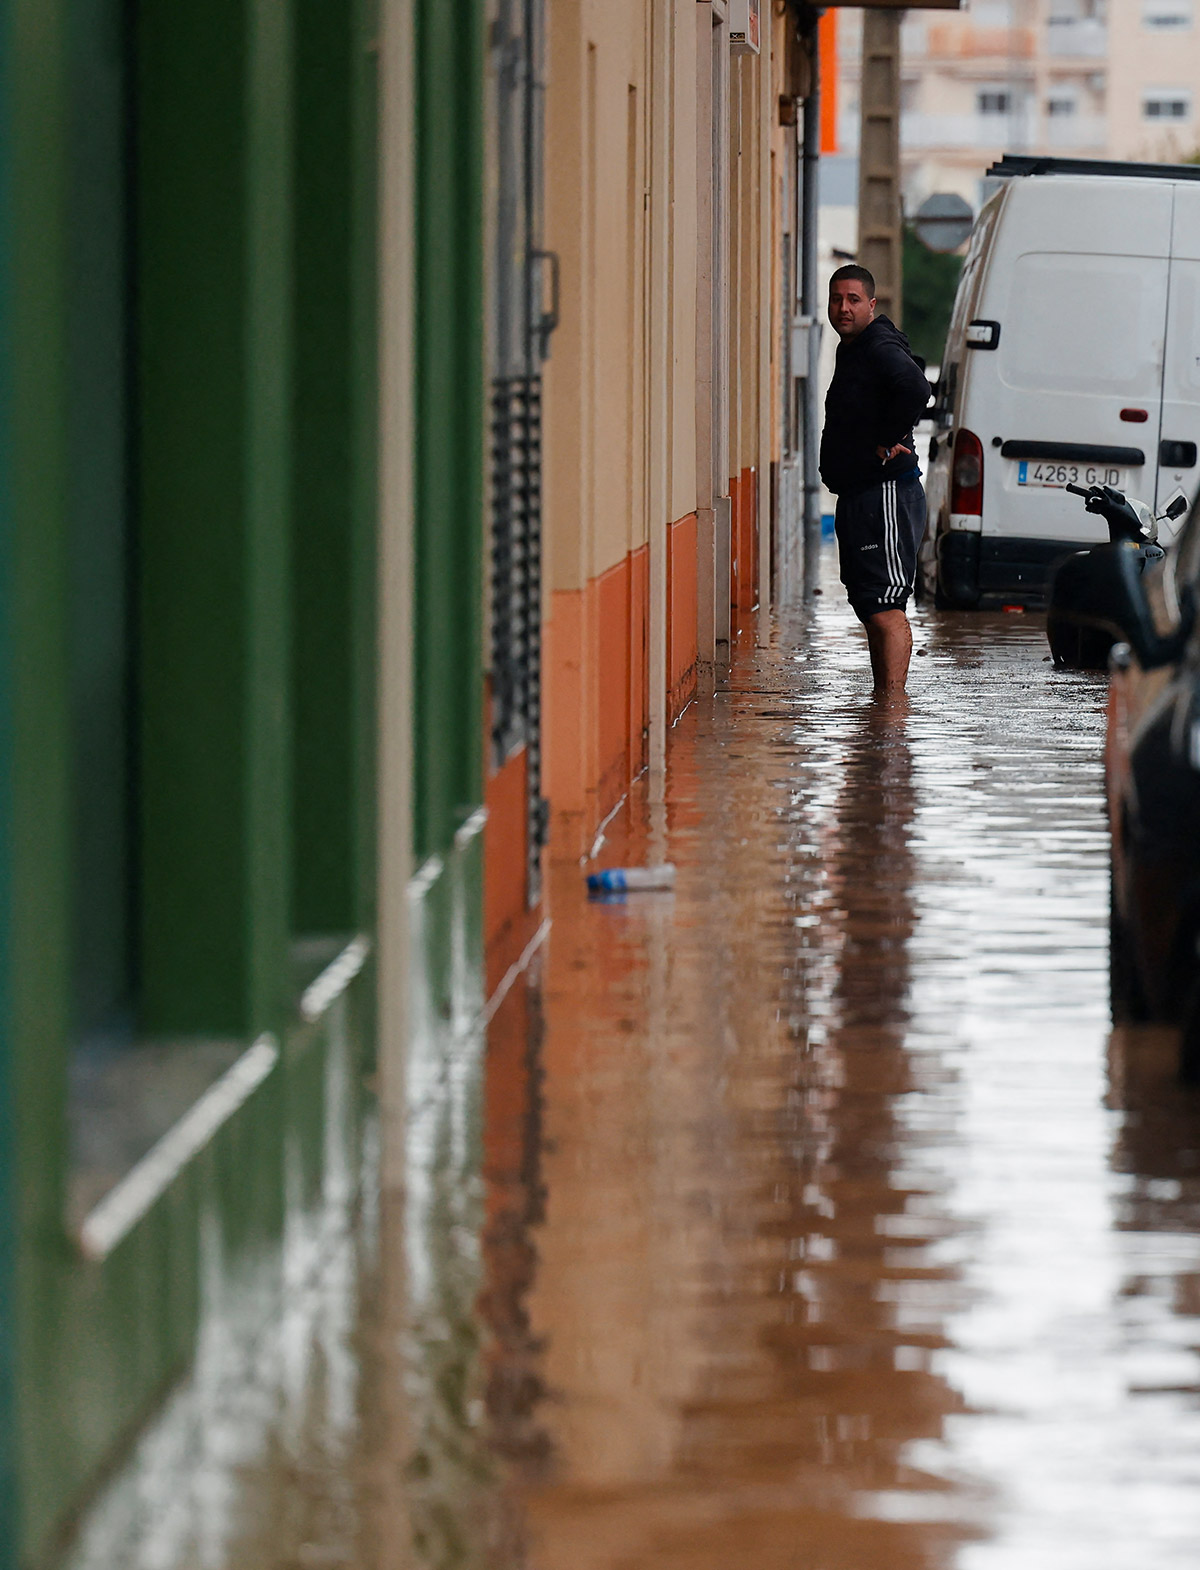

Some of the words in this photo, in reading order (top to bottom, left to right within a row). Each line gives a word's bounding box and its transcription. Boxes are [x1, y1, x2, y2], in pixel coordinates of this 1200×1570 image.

[1034, 464, 1078, 483] 4263
[1086, 467, 1119, 486] GJD
[860, 543, 878, 551] adidas
